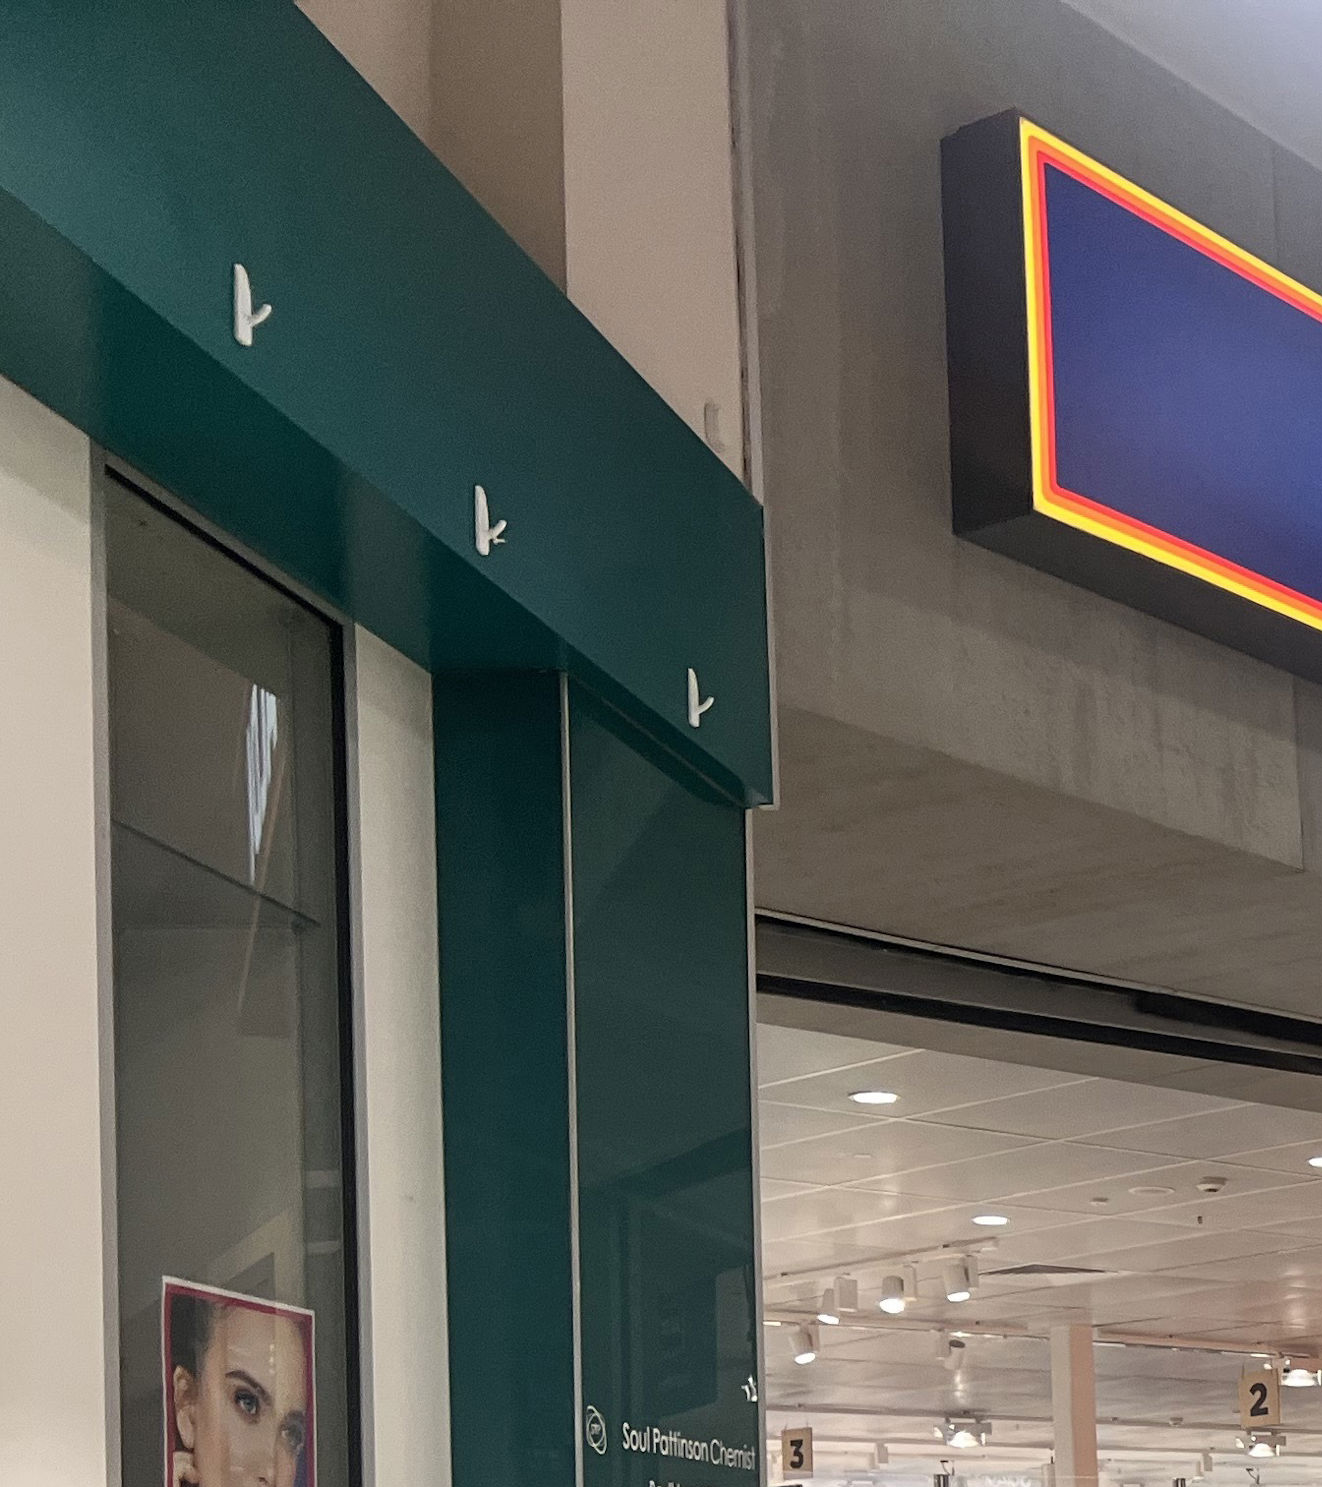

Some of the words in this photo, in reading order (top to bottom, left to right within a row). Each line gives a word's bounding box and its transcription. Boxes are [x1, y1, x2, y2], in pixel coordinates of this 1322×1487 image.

[1250, 1382, 1269, 1417] 2
[622, 1422, 650, 1453] Soul
[652, 1427, 709, 1462] Pattinson
[710, 1438, 756, 1471] Chemist
[789, 1439, 804, 1469] 3
